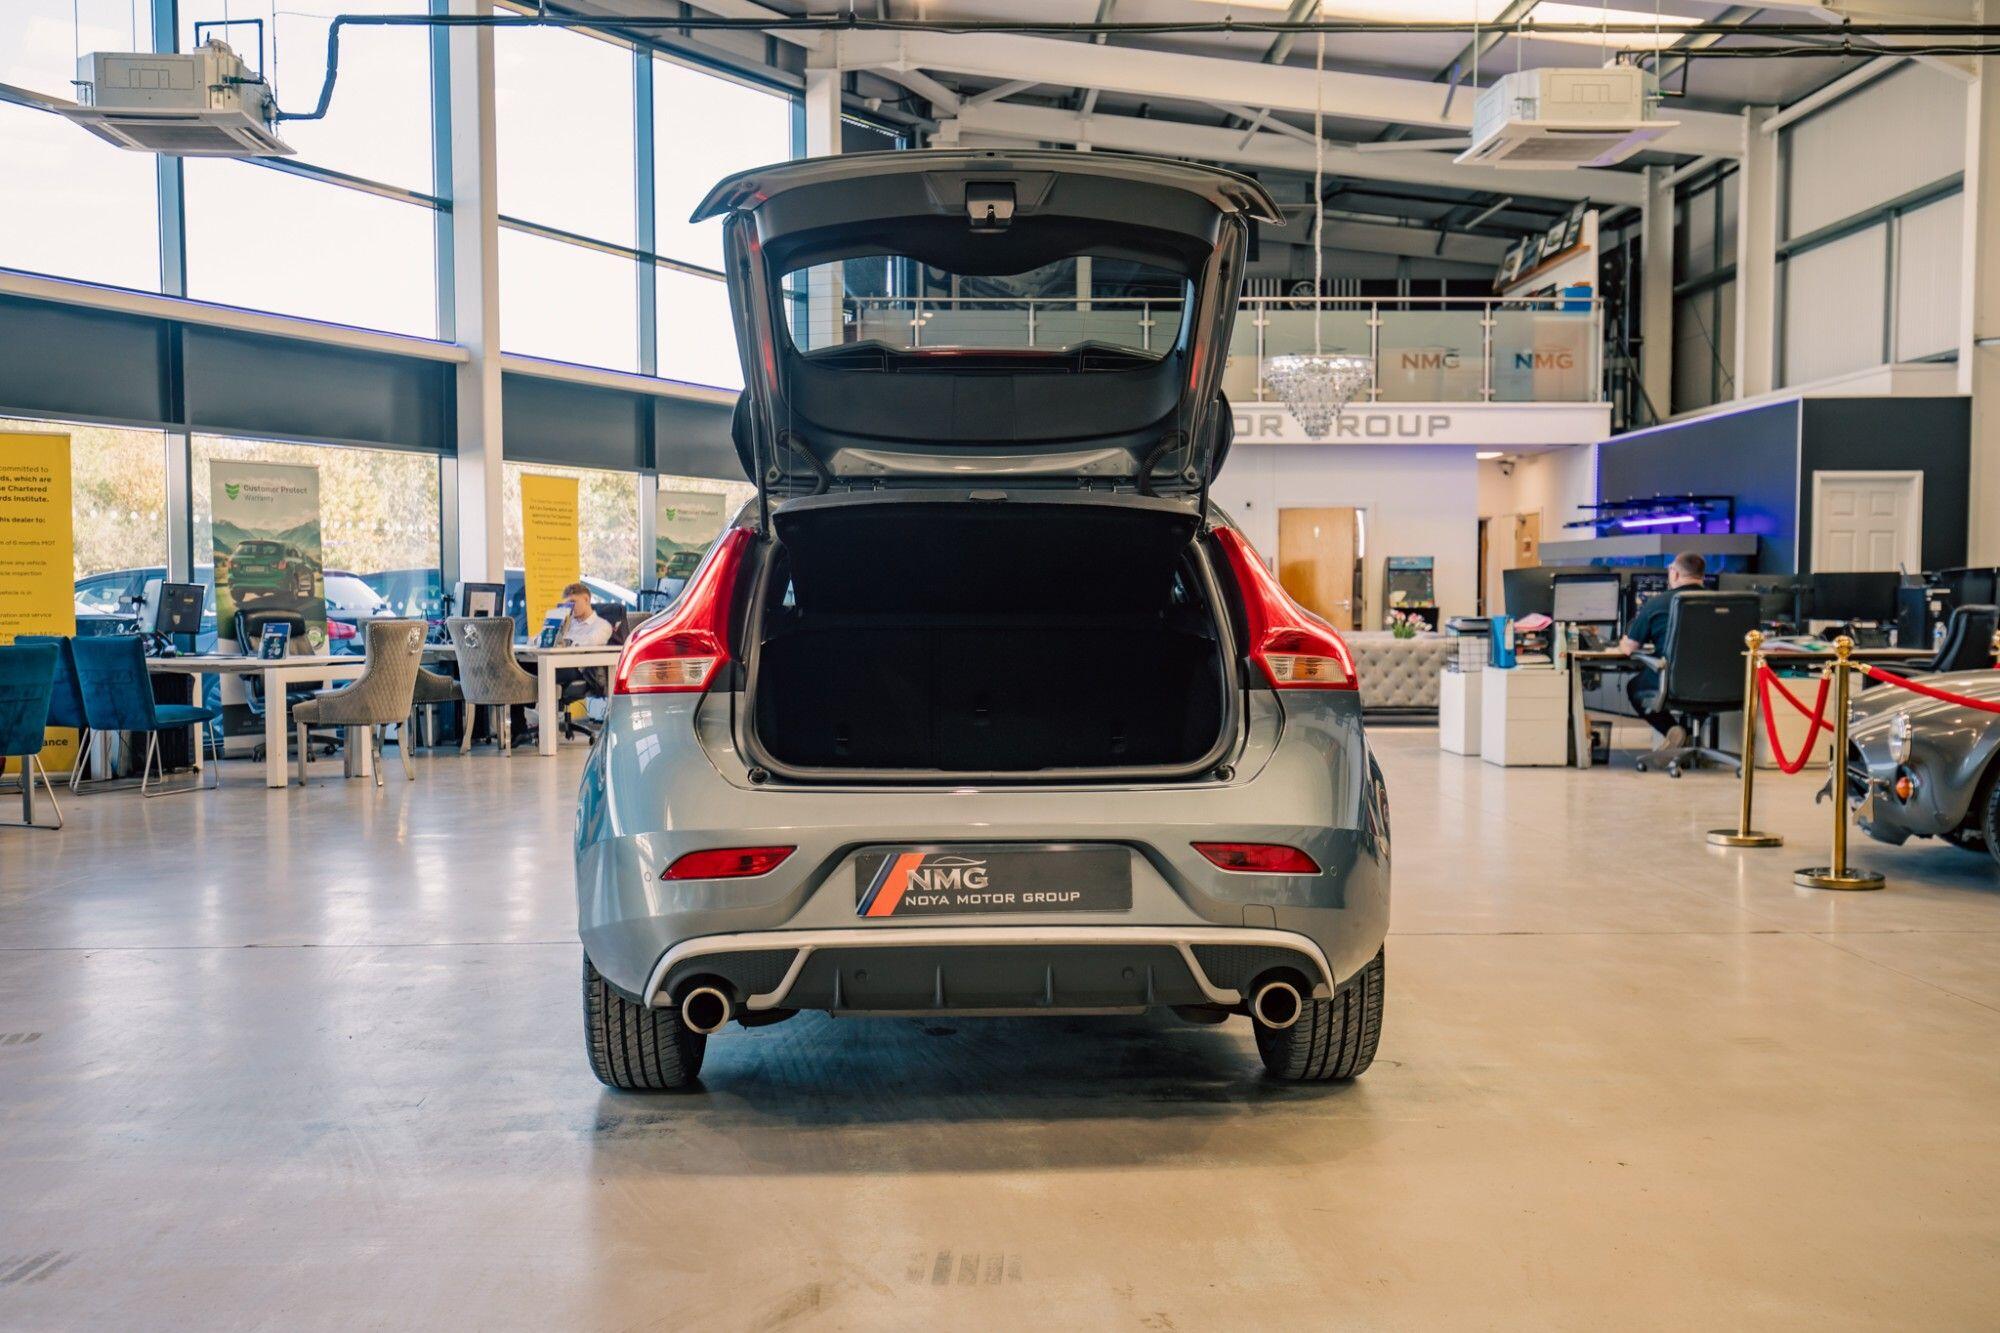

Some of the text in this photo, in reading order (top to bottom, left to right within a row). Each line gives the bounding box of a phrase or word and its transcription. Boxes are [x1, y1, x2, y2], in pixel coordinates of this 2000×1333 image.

[1402, 353, 1460, 369] NMG
[1515, 353, 1574, 369] NMG
[1234, 414, 1283, 437] OR
[8, 485, 48, 493] Chartered
[243, 484, 308, 495] Customer Protect
[906, 867, 989, 891] NMG
[905, 891, 1081, 906] NOYA MOTOR GROUP
